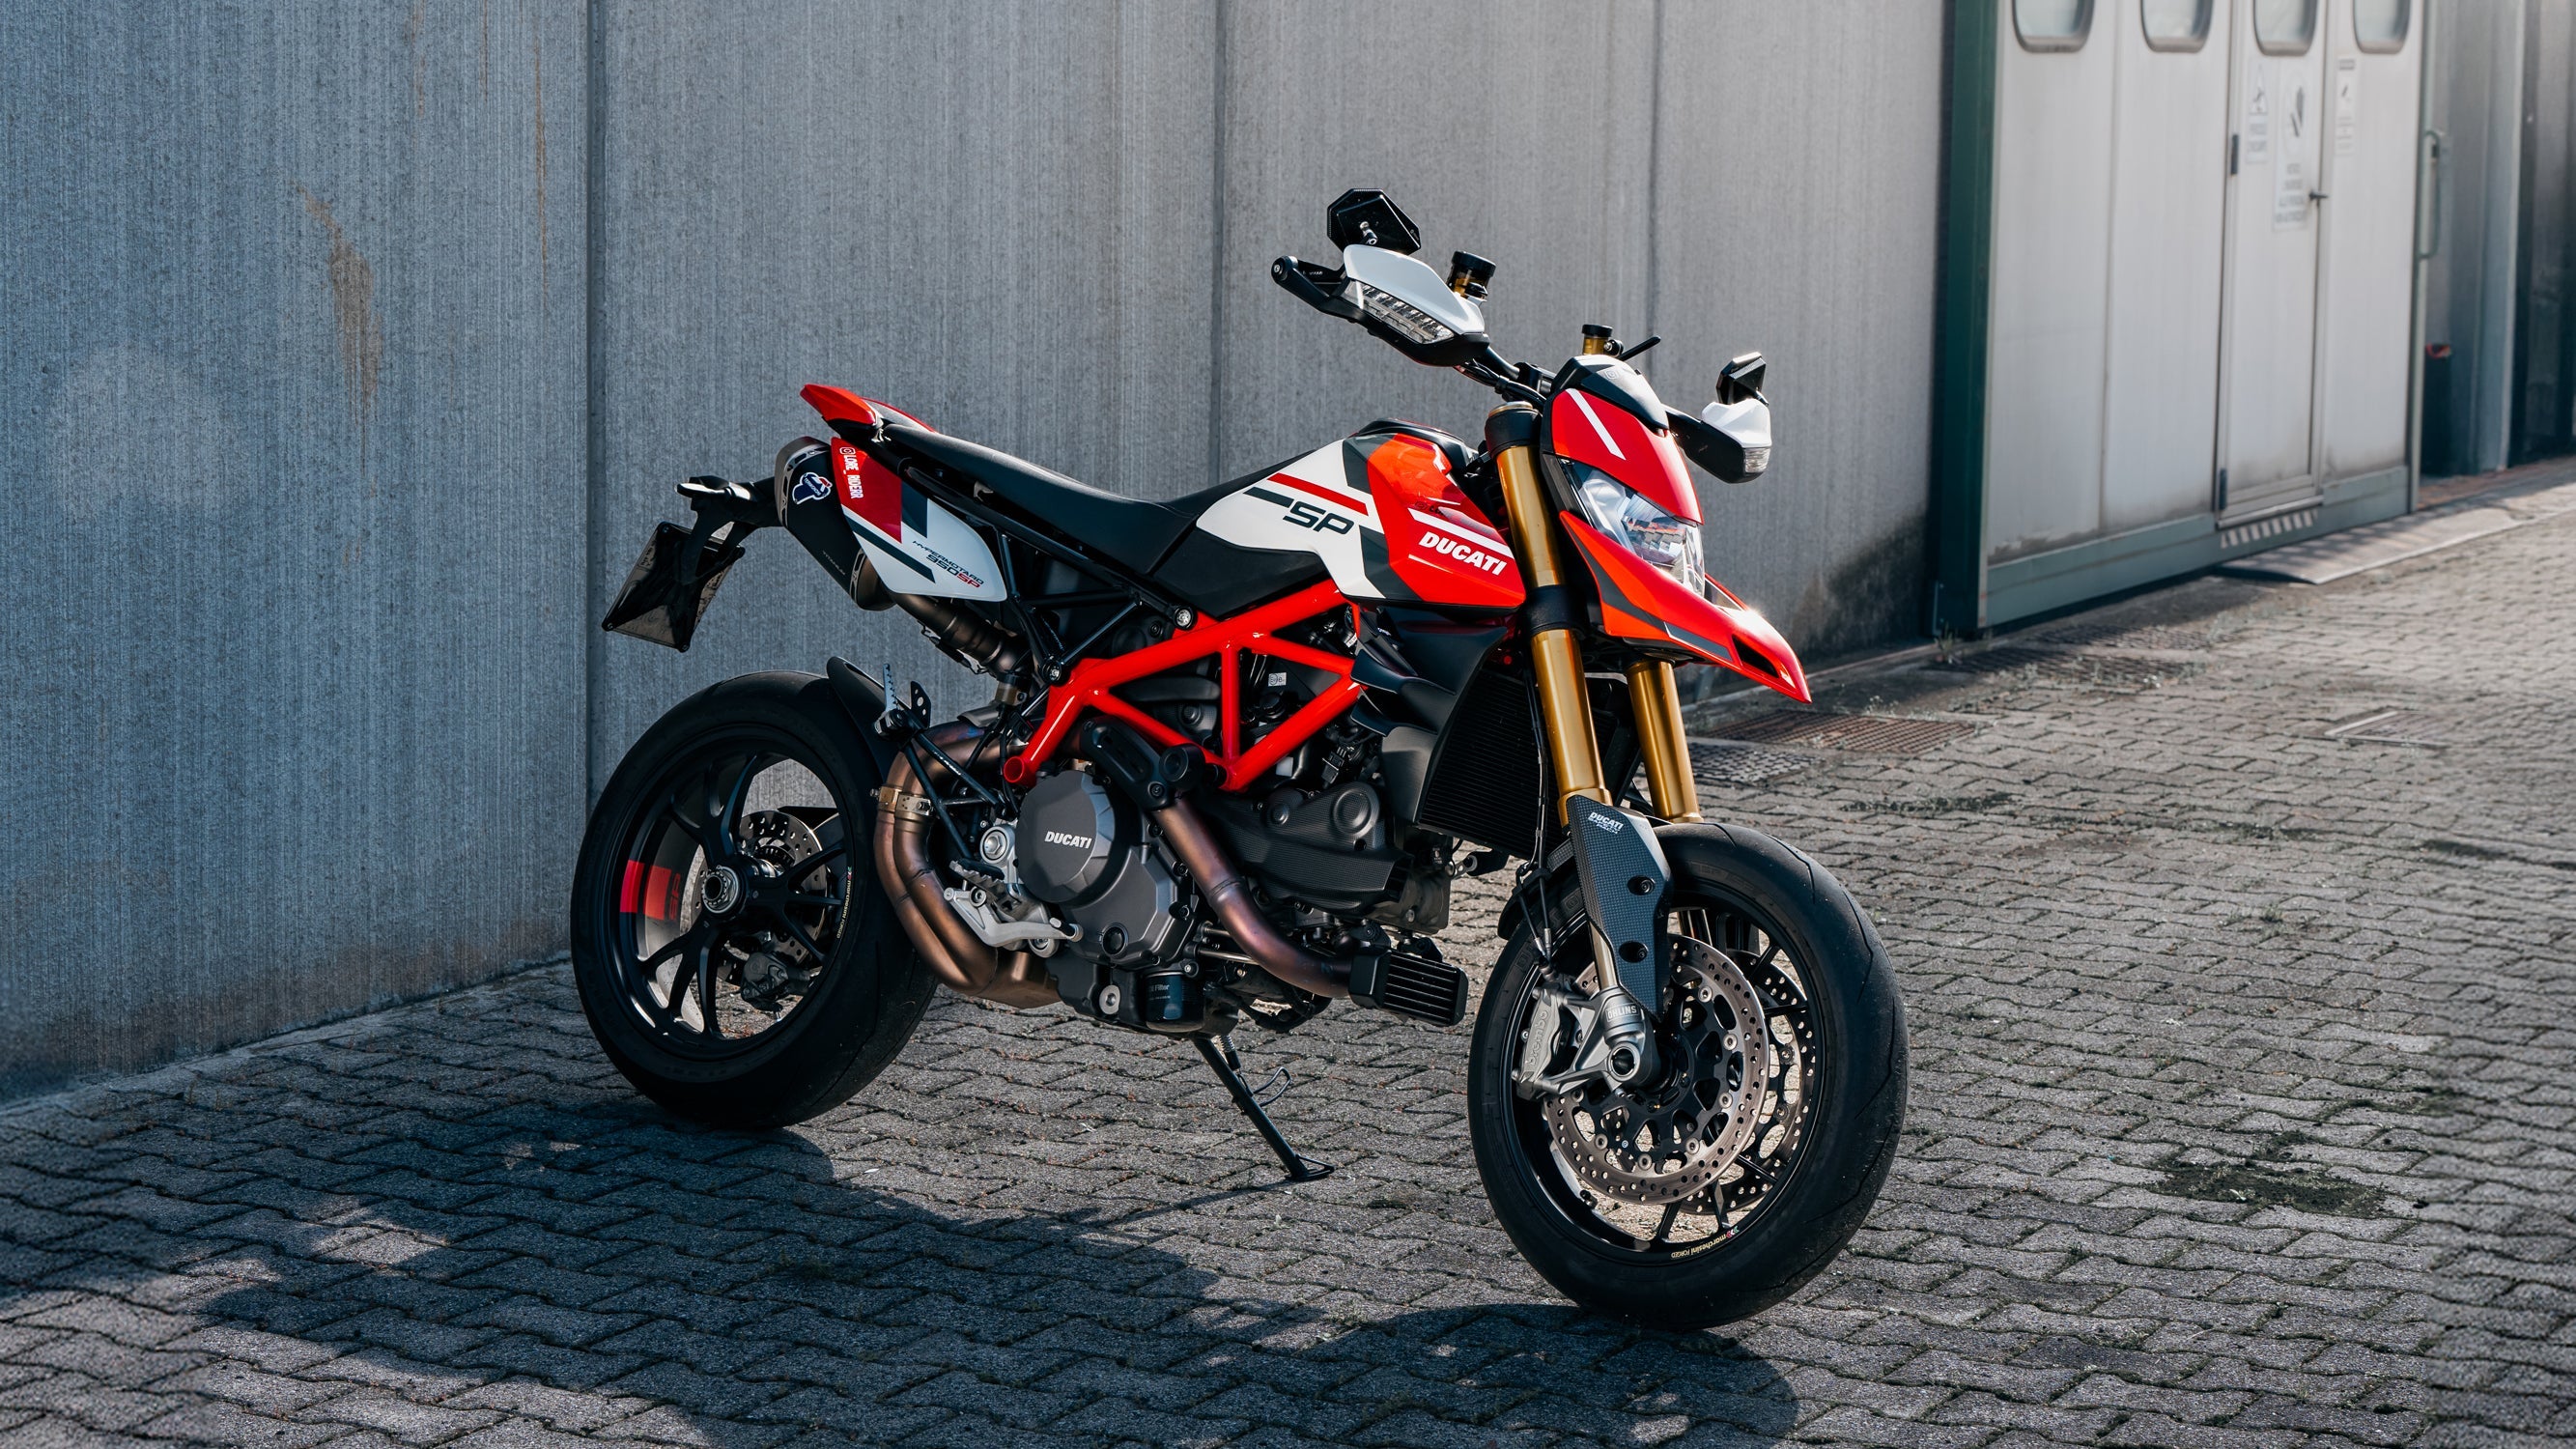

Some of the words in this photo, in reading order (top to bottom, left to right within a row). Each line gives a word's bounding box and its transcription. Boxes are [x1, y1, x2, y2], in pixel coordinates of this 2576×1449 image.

[1283, 500, 1355, 535] SP
[912, 540, 985, 585] HYPERMOTARD
[1418, 531, 1508, 577] DUCATI
[1588, 812, 1625, 830] DUCATI
[1044, 831, 1092, 849] DUCATI
[1528, 1009, 1549, 1065] brembo
[1691, 1234, 1726, 1256] marchesini
